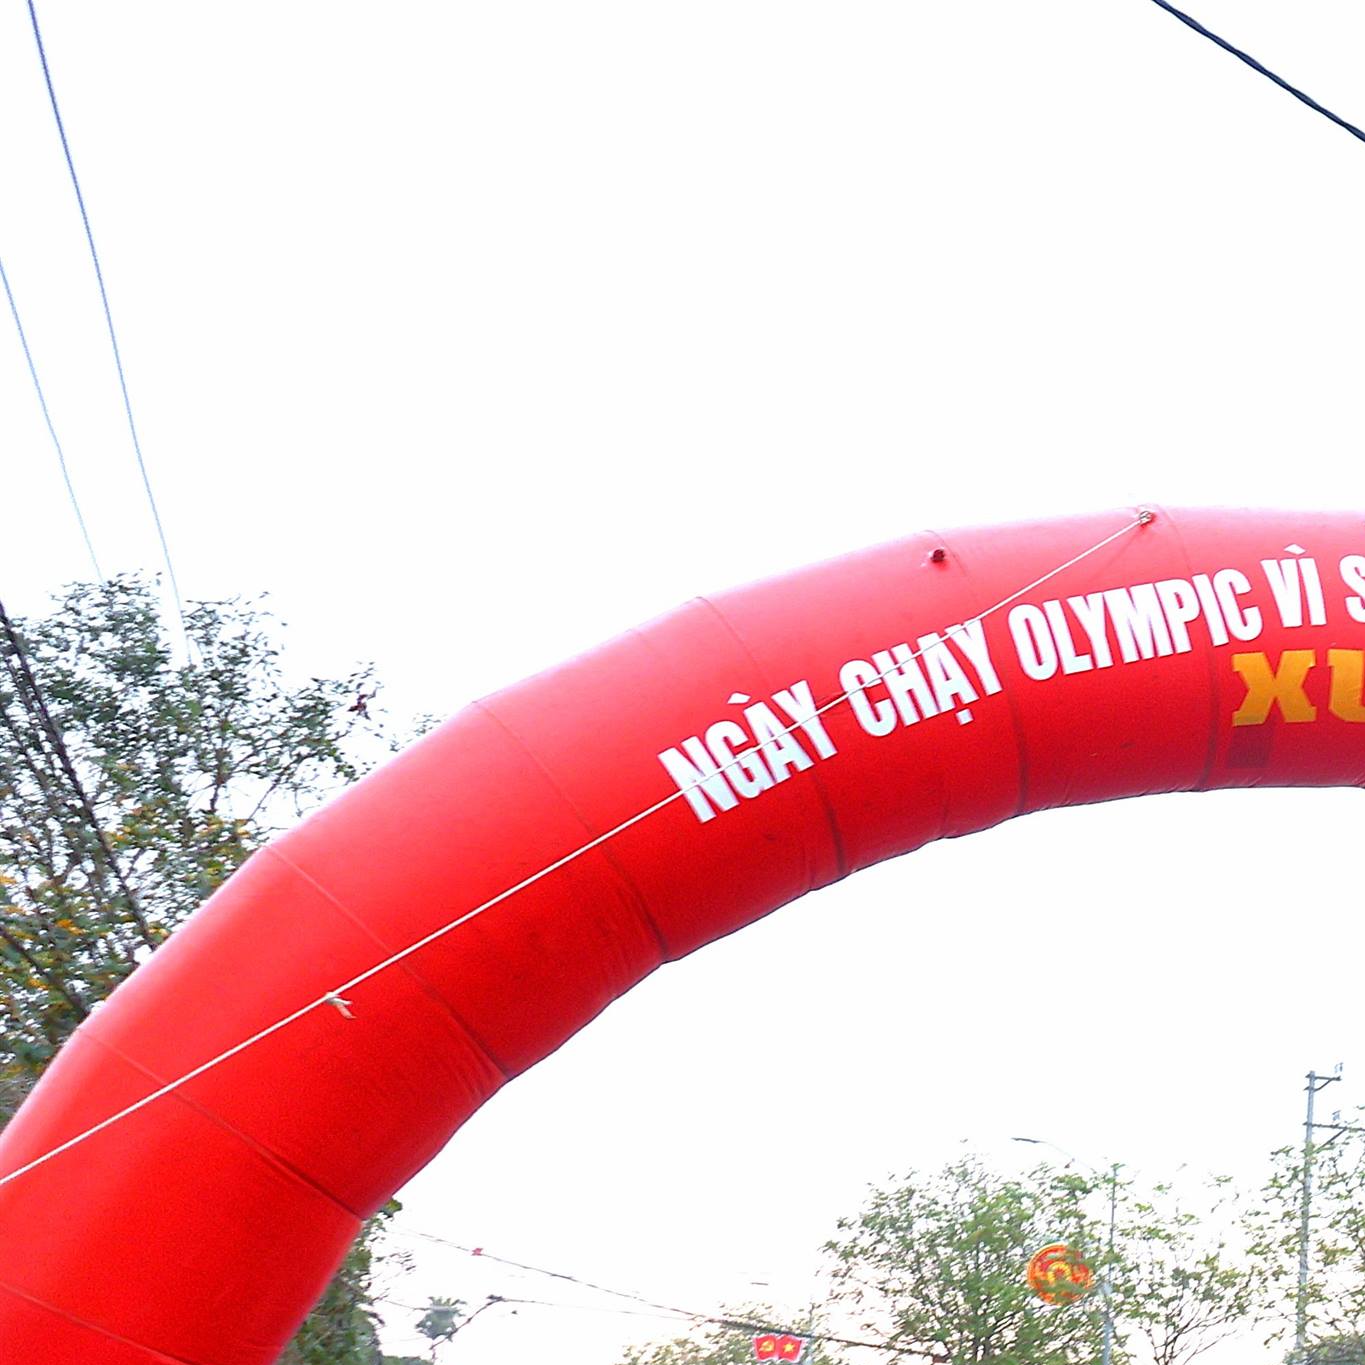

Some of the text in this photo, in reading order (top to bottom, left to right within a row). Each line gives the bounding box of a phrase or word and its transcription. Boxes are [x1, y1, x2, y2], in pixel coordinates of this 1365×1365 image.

[658, 680, 839, 823] NGÀY
[839, 620, 1002, 737] CHẠY
[1007, 568, 1264, 681] OLYMPIC
[1261, 544, 1327, 627] VÌ
